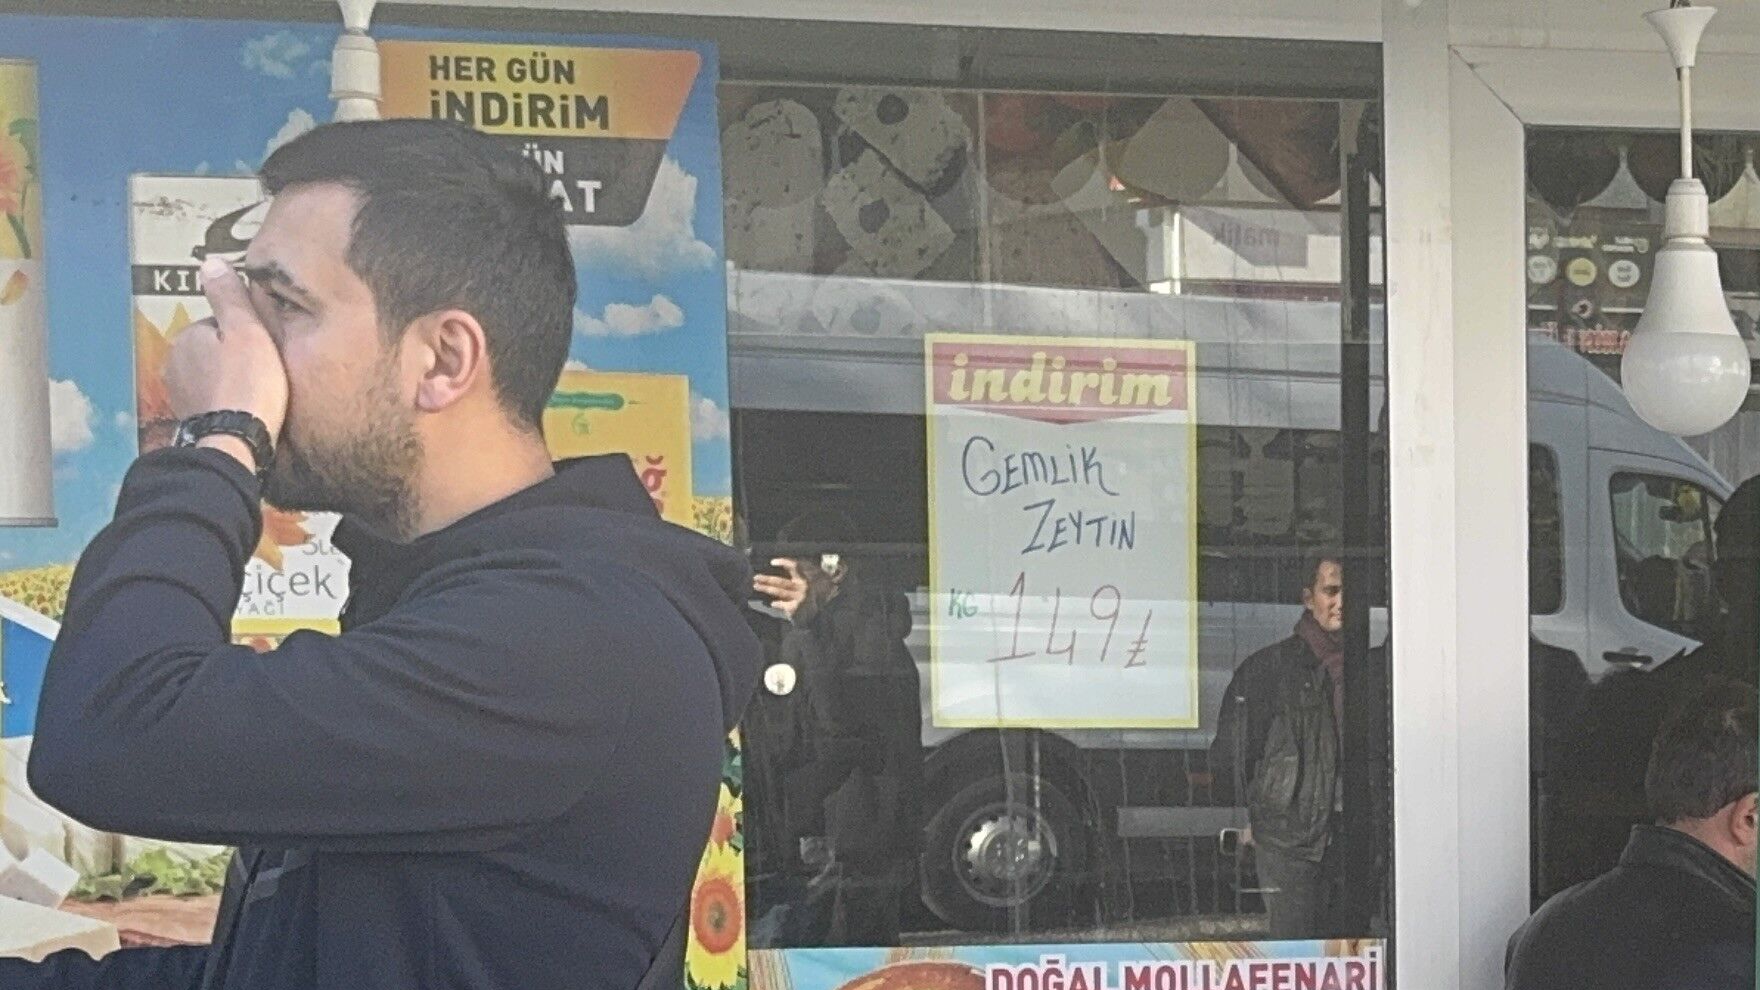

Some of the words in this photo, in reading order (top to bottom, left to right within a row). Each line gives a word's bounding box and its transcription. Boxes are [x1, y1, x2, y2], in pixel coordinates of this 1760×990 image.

[429, 55, 496, 82] HER
[506, 52, 575, 84] GÜN
[949, 352, 1173, 407] indirim
